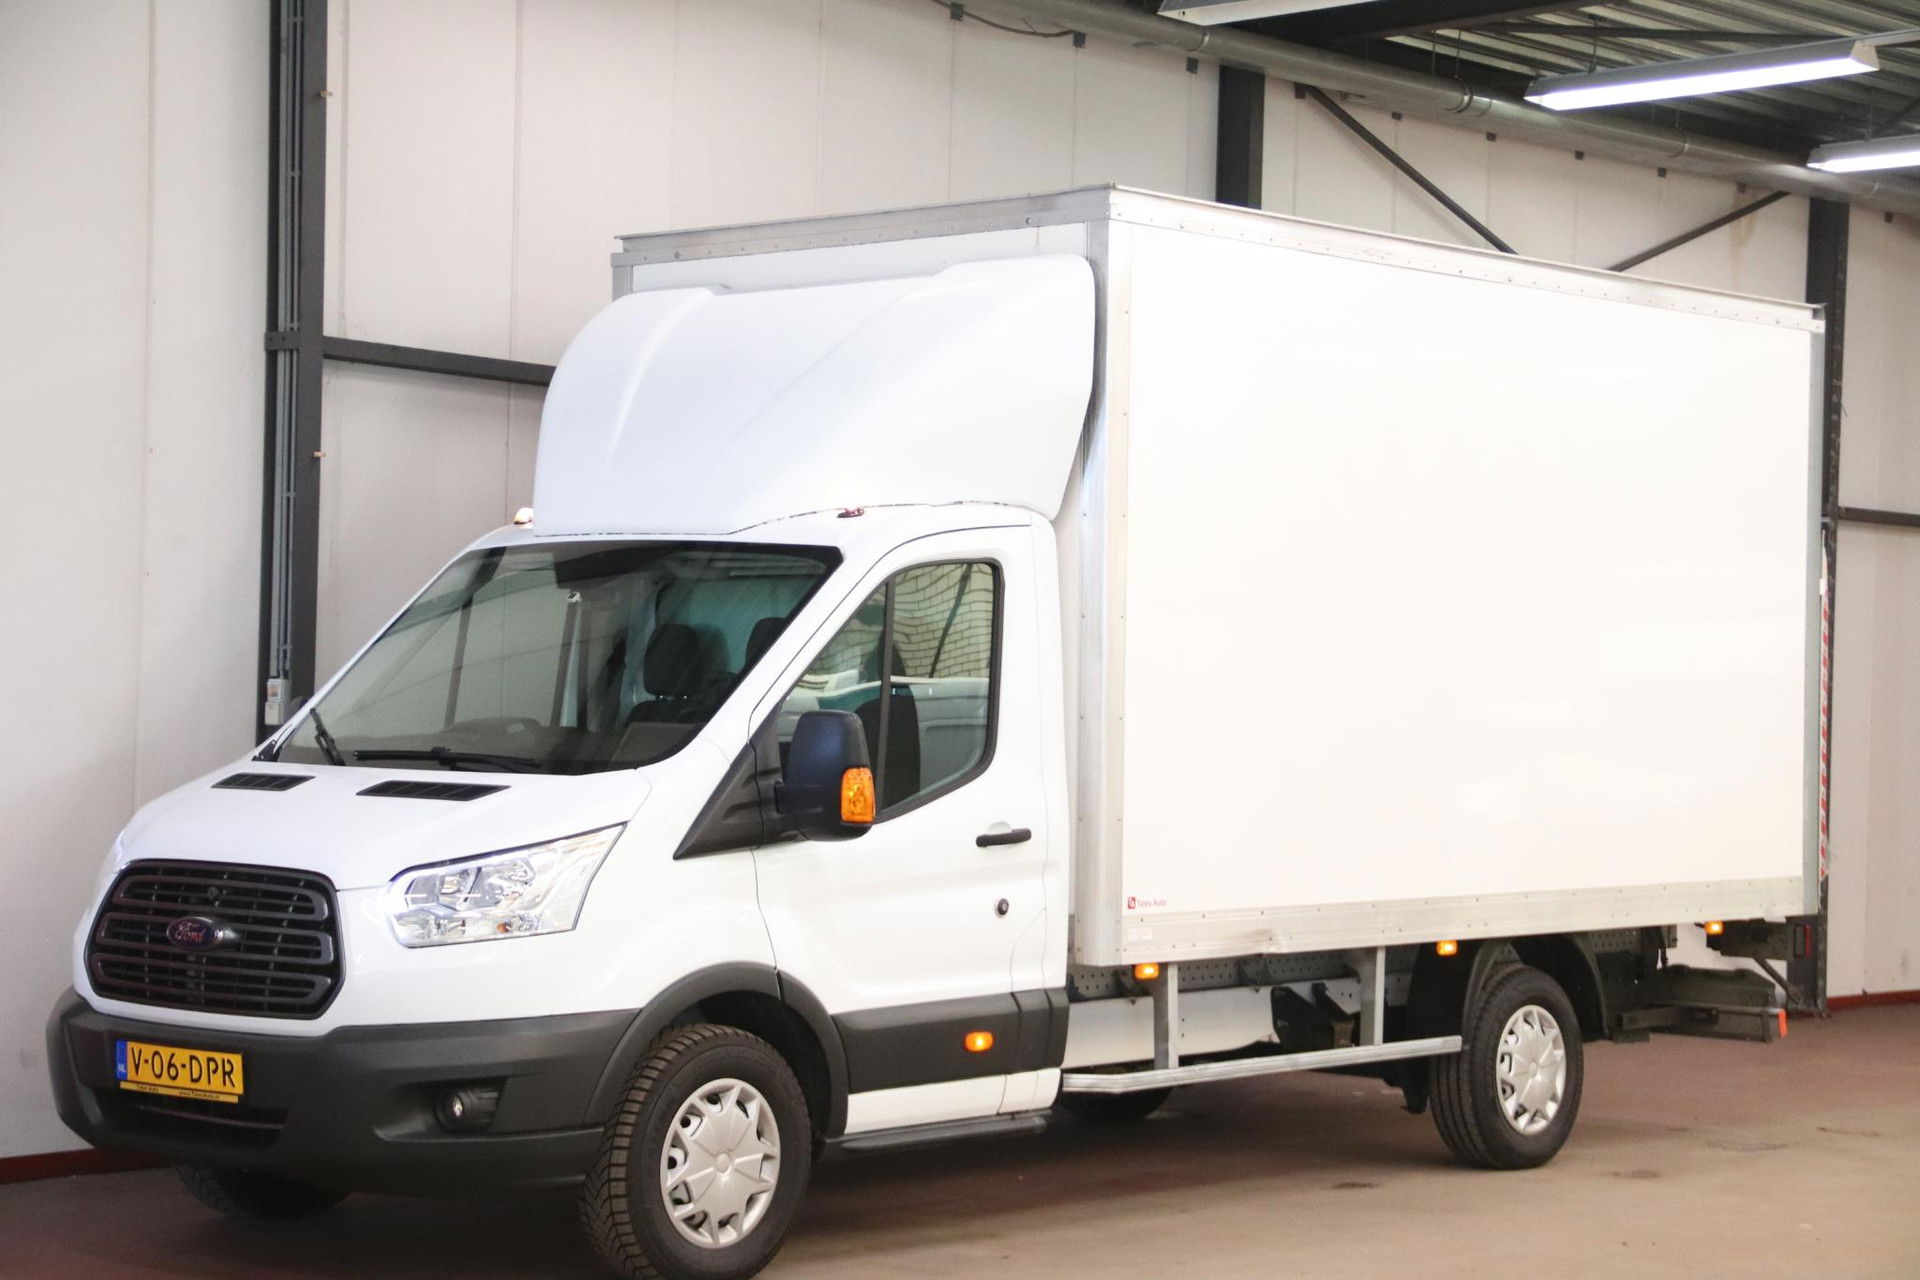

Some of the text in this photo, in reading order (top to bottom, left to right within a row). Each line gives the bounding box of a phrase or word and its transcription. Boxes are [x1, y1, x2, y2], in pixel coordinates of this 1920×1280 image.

[175, 922, 206, 941] Ford
[118, 1063, 126, 1073] NL
[131, 1047, 235, 1088] V-06-DPR
